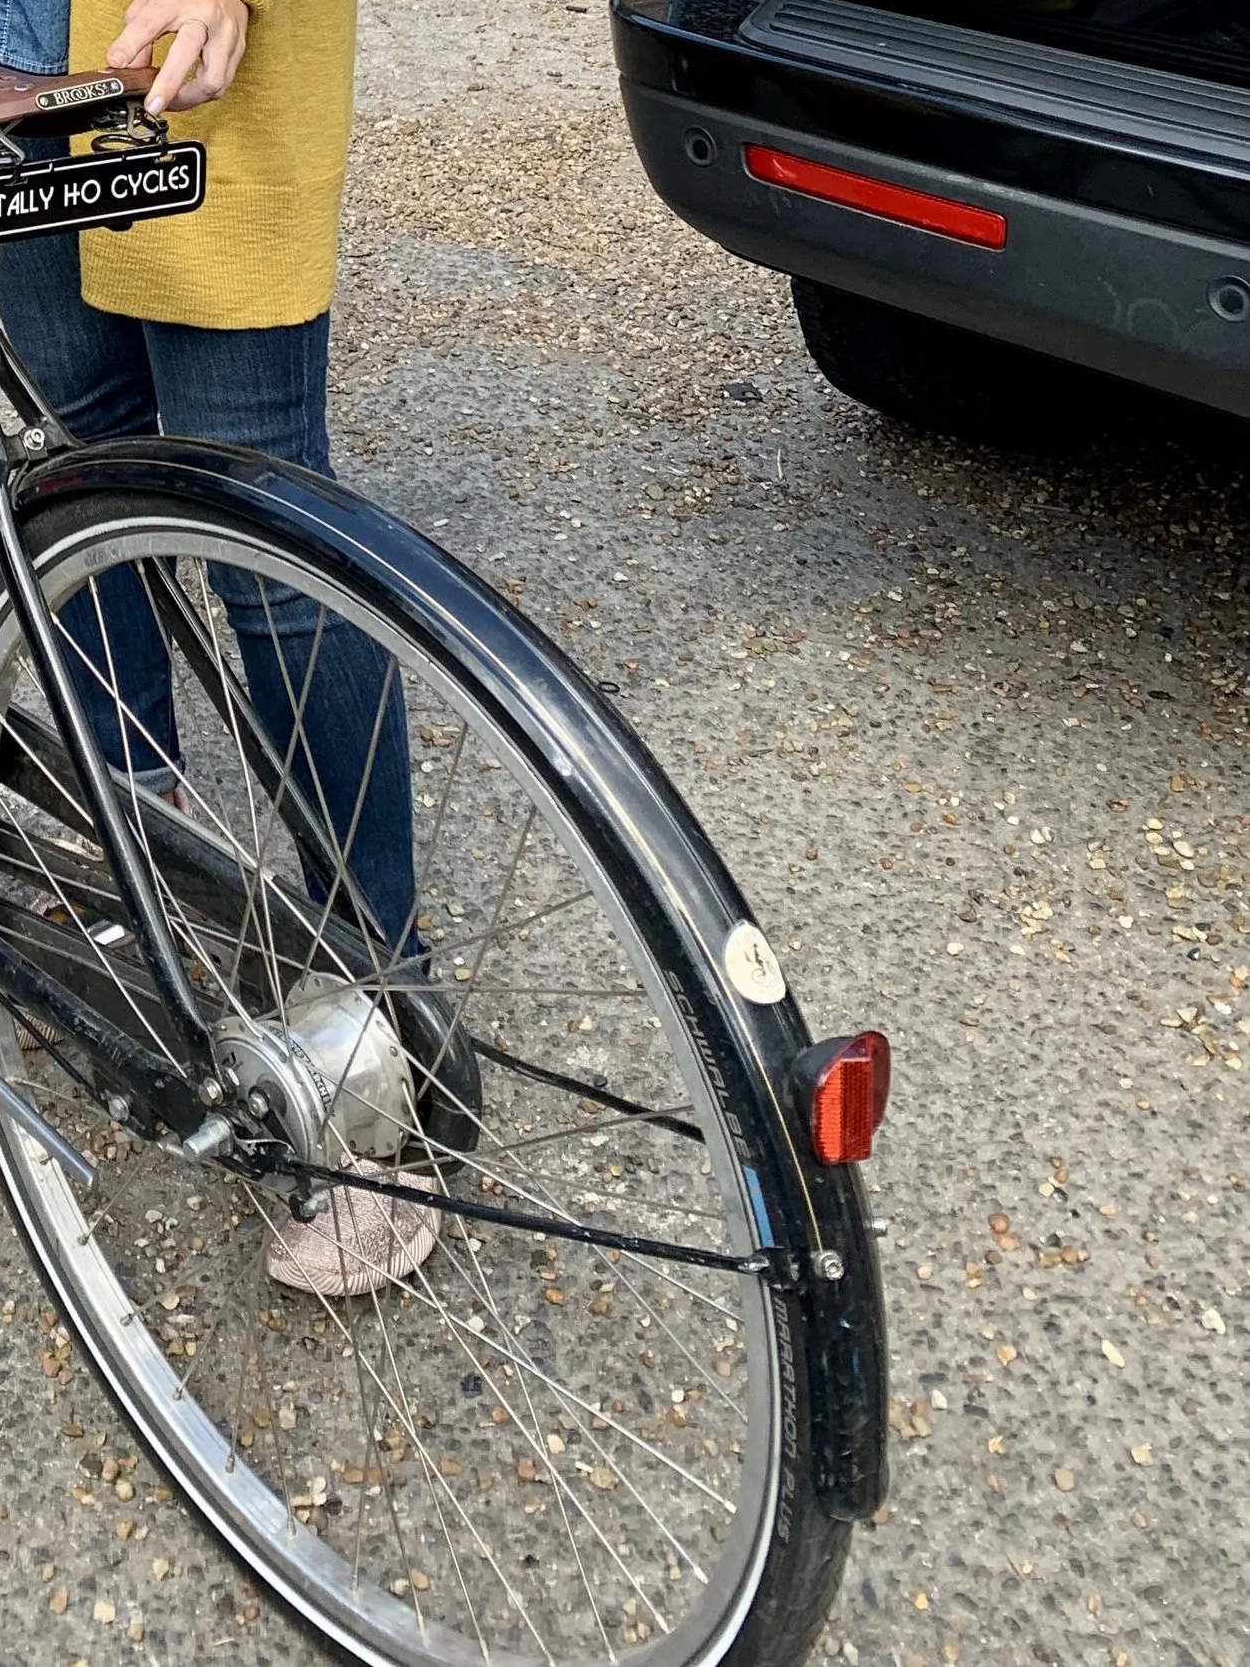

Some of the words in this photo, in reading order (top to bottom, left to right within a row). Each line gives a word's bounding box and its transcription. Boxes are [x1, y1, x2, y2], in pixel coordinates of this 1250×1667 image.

[53, 83, 105, 105] BROOKS
[64, 179, 101, 207] HO
[110, 164, 190, 198] CYCLES
[664, 968, 750, 1160] SCHWALBE
[773, 1296, 798, 1460] MARATHON
[777, 1466, 797, 1544] PLUS
